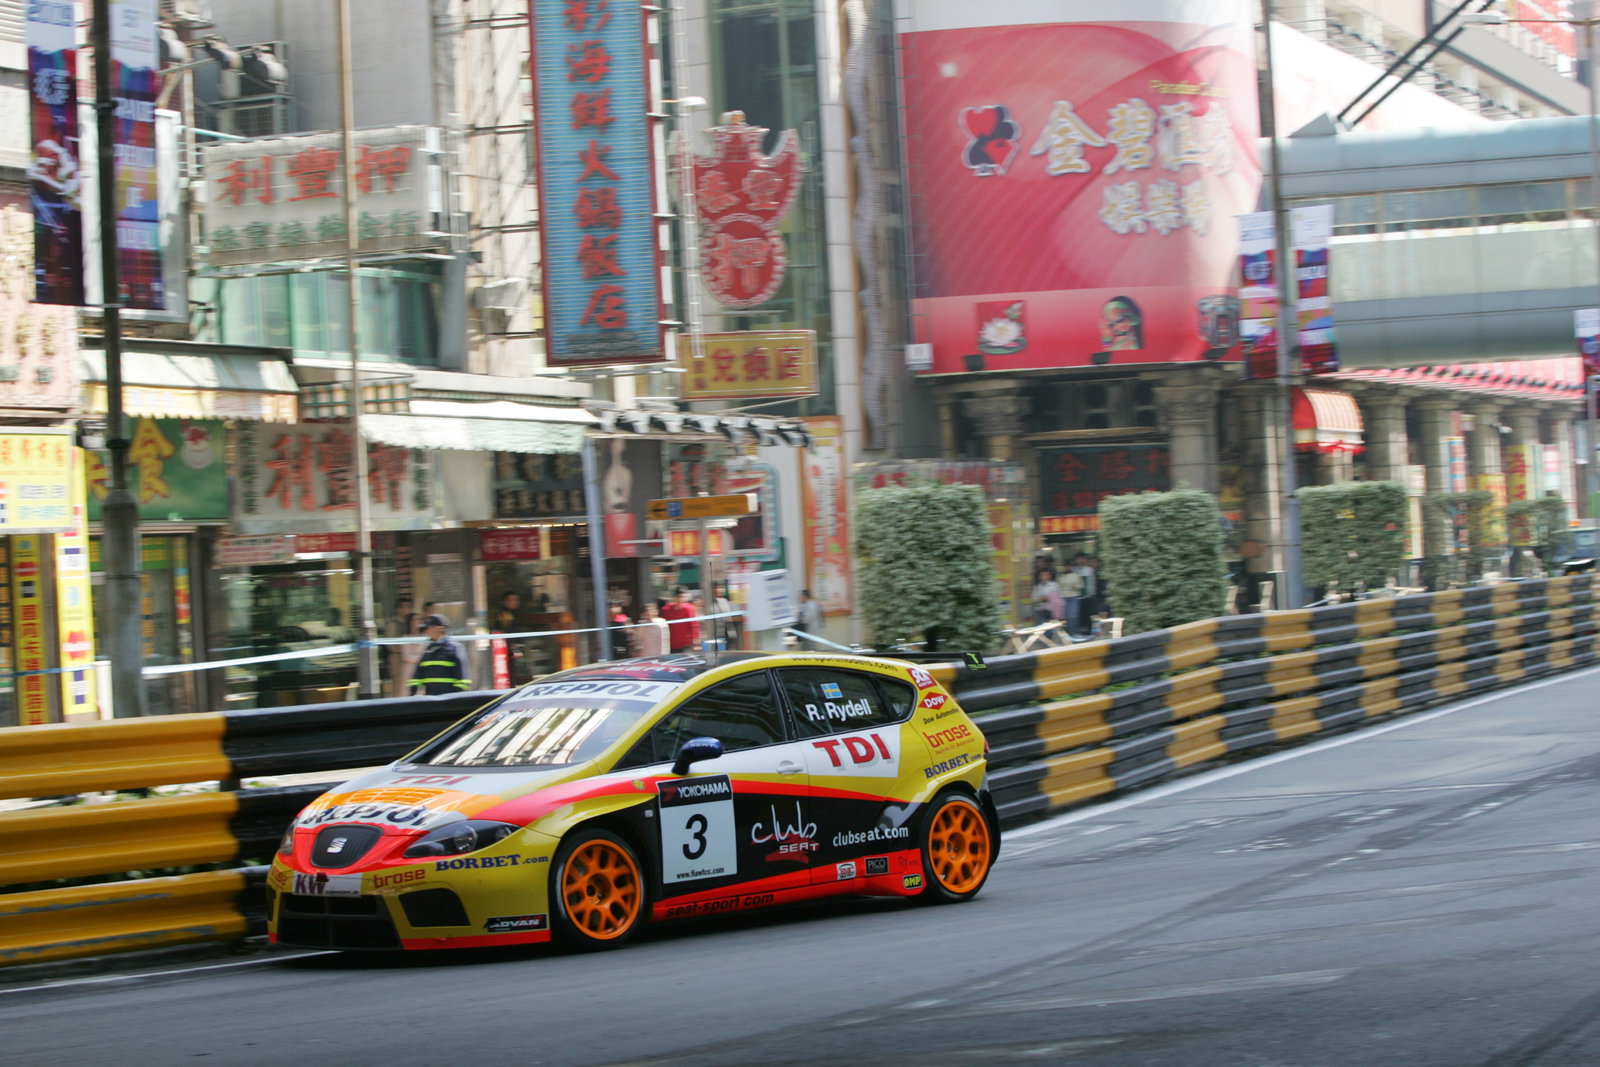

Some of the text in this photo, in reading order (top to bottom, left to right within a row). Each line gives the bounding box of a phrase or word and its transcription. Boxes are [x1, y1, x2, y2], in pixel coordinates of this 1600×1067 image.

[520, 682, 655, 699] REPSOL
[805, 703, 824, 722] R.
[824, 698, 872, 723] Rydell
[922, 724, 972, 749] brose
[812, 733, 891, 768] TDI
[677, 782, 730, 799] YOKOHAMA
[751, 800, 817, 844] club
[682, 813, 709, 861] 3
[832, 826, 910, 848] clubseat.com
[779, 842, 819, 855] SEAT
[294, 873, 327, 895] KW
[373, 868, 426, 889] brose
[903, 876, 921, 887] OMP
[490, 918, 540, 929] ADVAN
